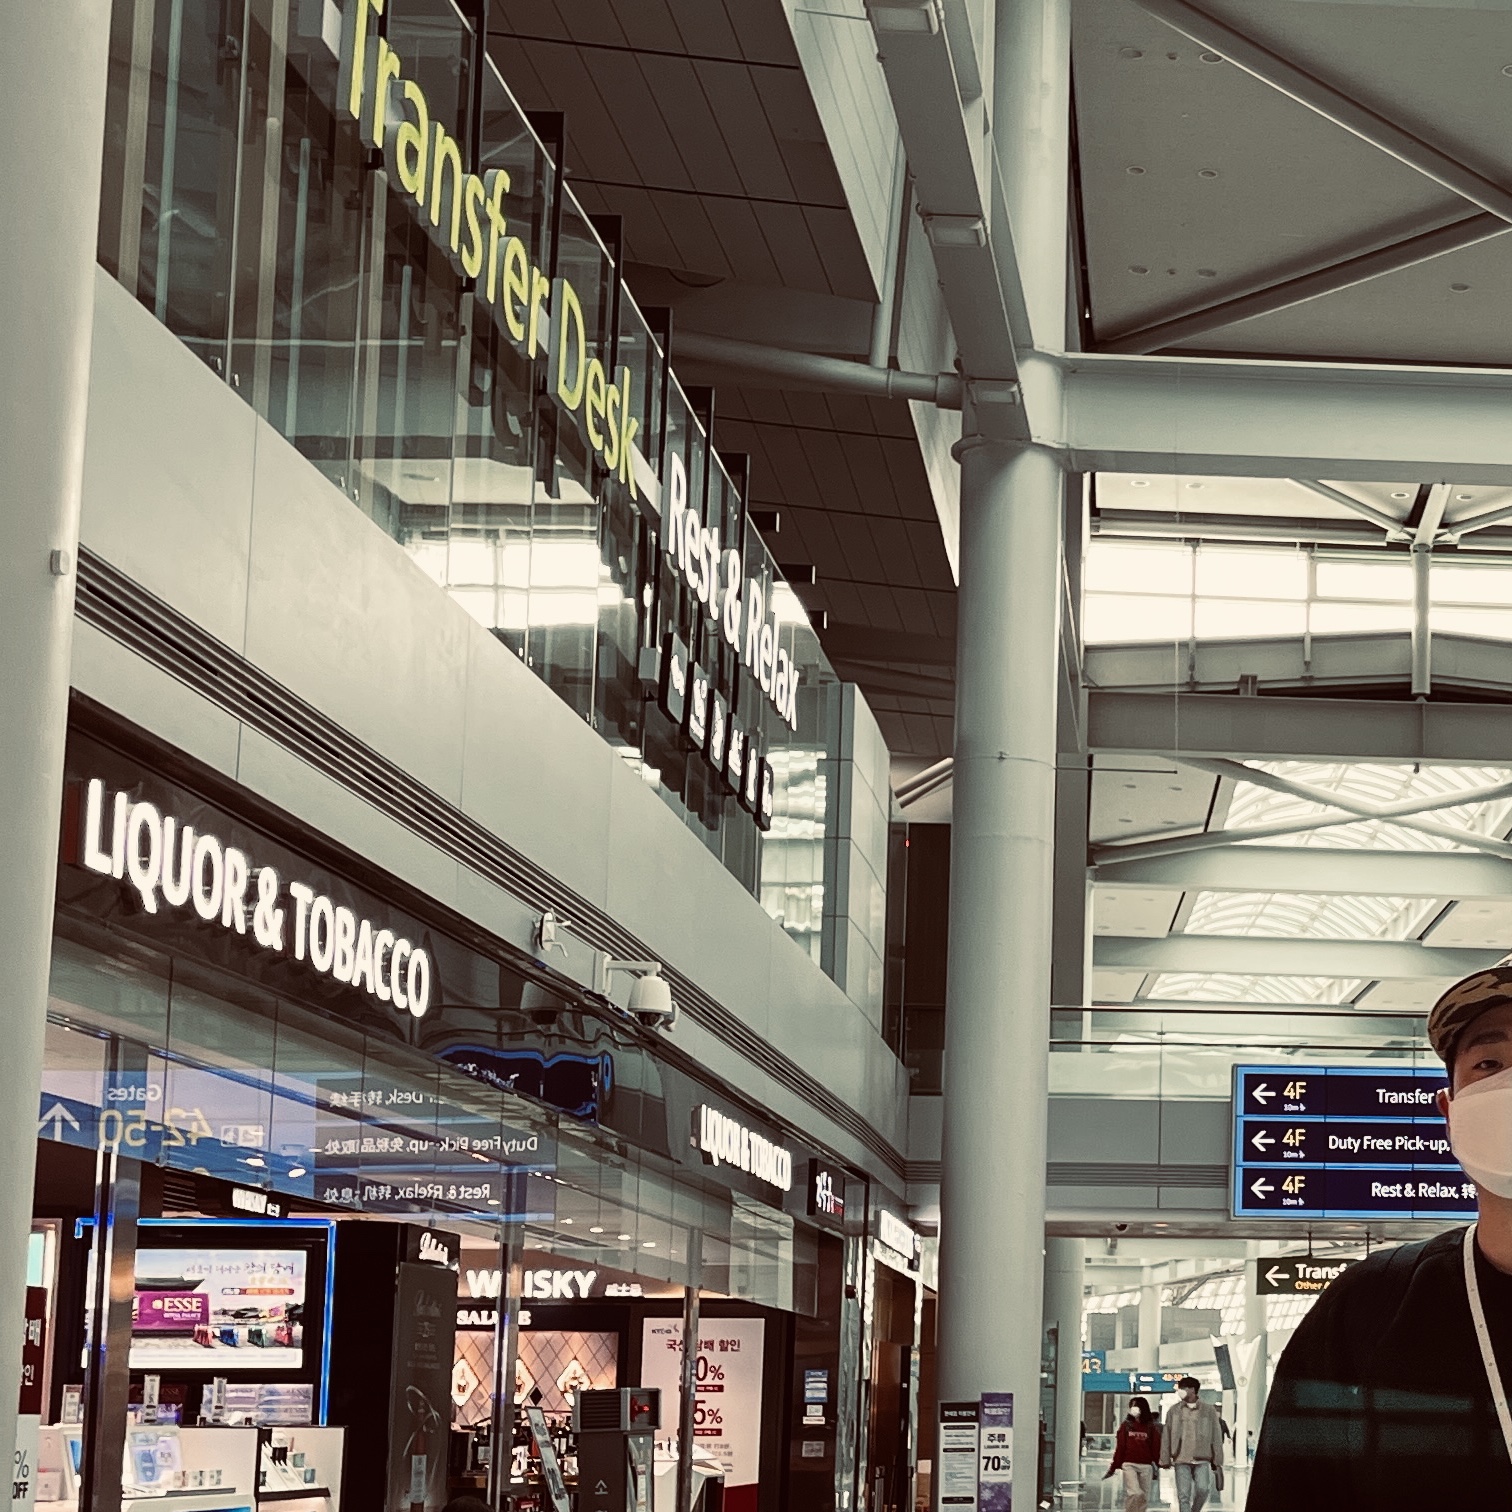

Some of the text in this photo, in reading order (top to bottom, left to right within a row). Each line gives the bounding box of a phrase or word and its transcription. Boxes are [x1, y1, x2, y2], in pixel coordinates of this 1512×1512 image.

[346, 0, 639, 498] Transfer Desk
[668, 451, 800, 732] Rest & Relax
[84, 778, 430, 1017] LIQUOR & TOBACCO
[1283, 1081, 1435, 1105] 4F Transfer
[1281, 1128, 1306, 1147] 4F
[1328, 1135, 1361, 1153] Duty
[1363, 1135, 1392, 1150] Free
[1281, 1175, 1478, 1199] 4F Rest & Relax, 转
[466, 1269, 597, 1299] WISKY
[163, 1297, 203, 1313] ESSE
[23, 1318, 42, 1347] 배
[718, 1339, 741, 1352] 할인
[21, 1364, 35, 1387] 인
[679, 1355, 725, 1382] 0%
